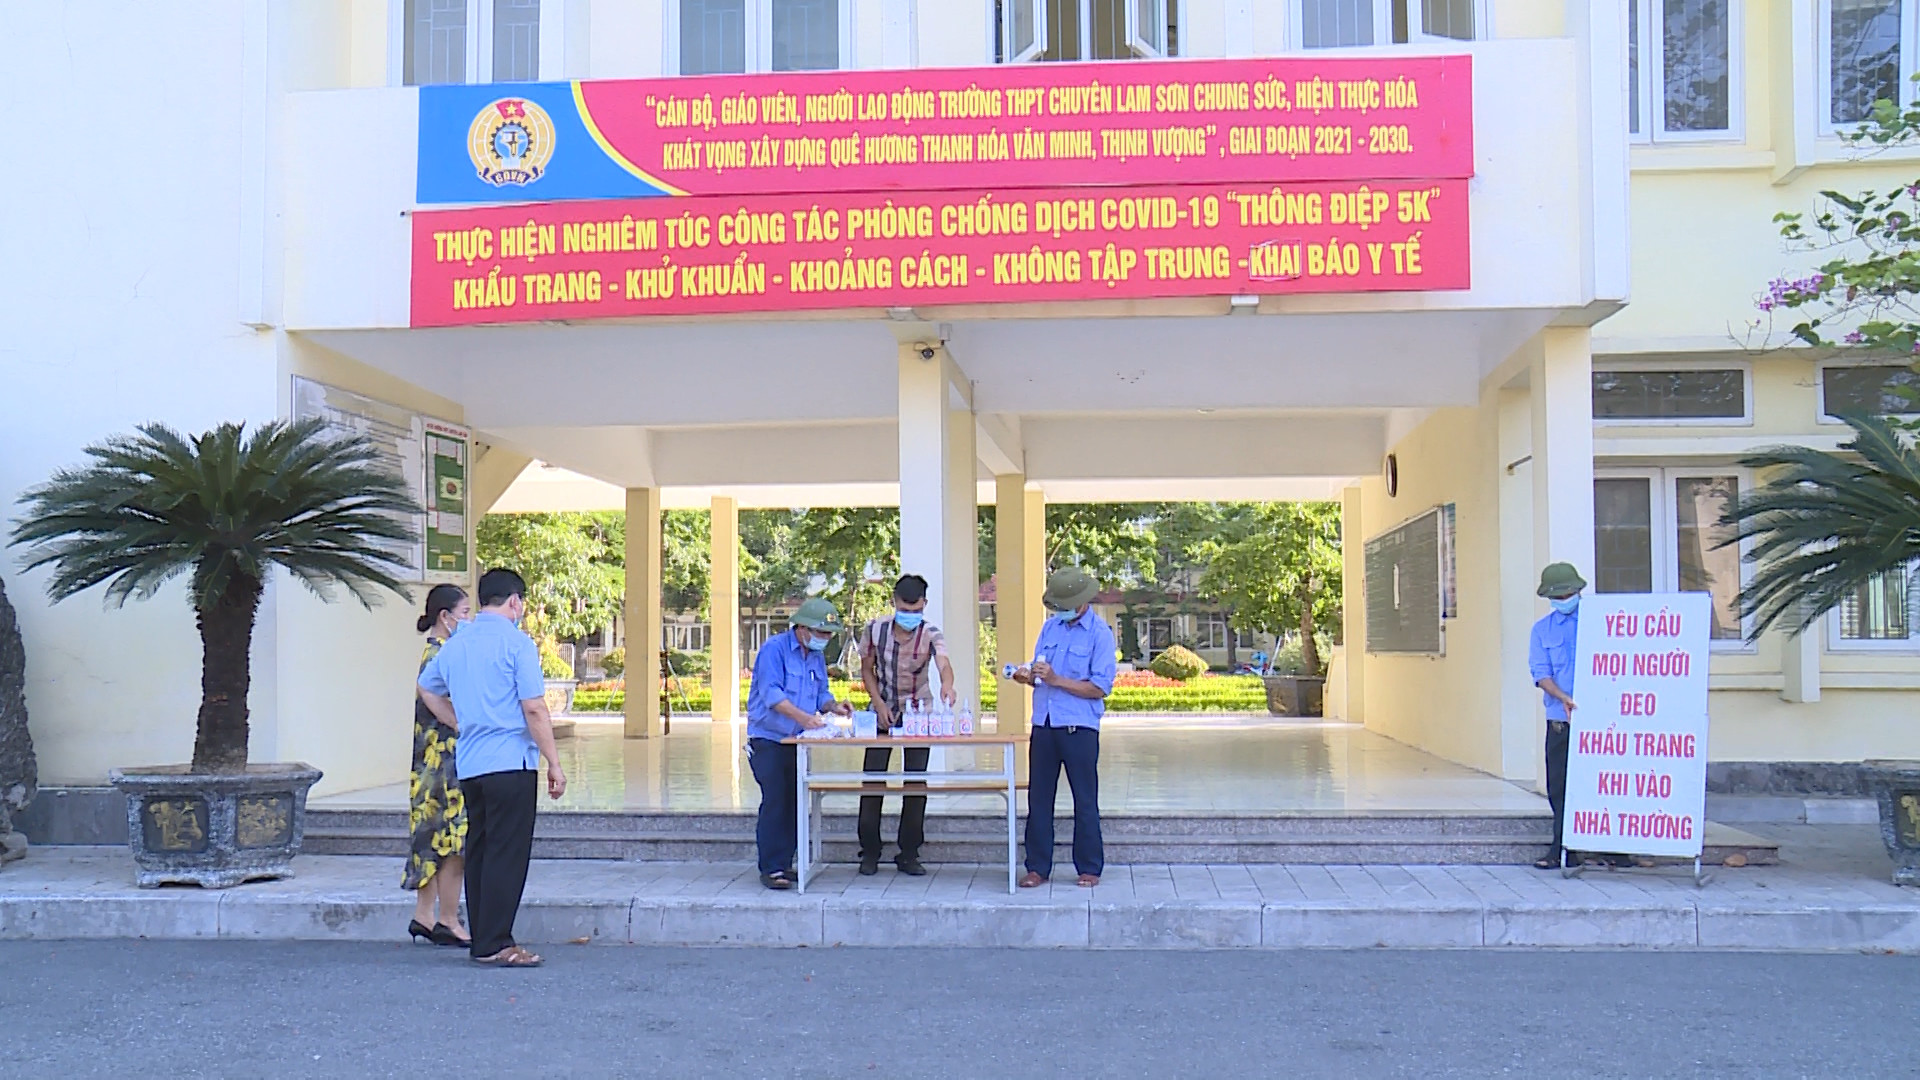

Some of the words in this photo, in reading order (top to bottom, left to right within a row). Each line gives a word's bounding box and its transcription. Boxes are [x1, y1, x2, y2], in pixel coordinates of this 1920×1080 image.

[691, 94, 717, 131] BỘ,
[721, 92, 758, 125] GIÁO
[761, 90, 801, 126] VIÊN,
[805, 87, 854, 123] NGƯỜI
[857, 93, 888, 121] LAO
[890, 86, 935, 125] ĐỘNG
[939, 82, 1002, 119] TRƯỜNG
[1005, 87, 1045, 116] THPT
[1048, 80, 1112, 115] CHUYÊN
[1116, 85, 1151, 113] LAM
[1155, 82, 1190, 113] SƠN
[1193, 82, 1249, 111] CHUNG
[1253, 74, 1291, 112] SỨC,
[1295, 76, 1334, 115] HIỆN
[1338, 78, 1380, 114] THỰC
[1384, 75, 1418, 109] HÓA
[663, 138, 702, 171] KHÁT
[705, 140, 746, 175] VỌNG
[750, 134, 780, 167] XÂY
[783, 136, 827, 172] DỰNG
[830, 132, 860, 168] QUÊ
[864, 134, 918, 164] HƯƠNG
[921, 134, 973, 162] THANH
[977, 127, 1009, 161] HÓA
[1012, 126, 1045, 160] VĂN
[1049, 130, 1097, 161] MINH,
[1101, 129, 1148, 163] THỊNH
[1229, 126, 1262, 155] GIAI
[1265, 126, 1311, 160] ĐOẠN
[1314, 126, 1352, 154] 2021
[1369, 125, 1413, 154] 2030.
[433, 226, 493, 266] THỰC
[500, 219, 556, 263] HIỆN
[562, 214, 658, 254] NGHIÊM
[663, 211, 711, 248] TÚC
[718, 207, 786, 246] CÔNG
[792, 205, 840, 243] TÁC
[845, 199, 933, 240] PHÒNG
[940, 192, 1028, 236] CHỐNG
[1035, 199, 1096, 239] DỊCH
[1101, 195, 1219, 230] COVID-19
[1226, 187, 1323, 226] “THÔNG
[1329, 185, 1390, 231] ĐIỆP
[1397, 187, 1441, 223] 5K”
[453, 265, 516, 310] KHẨU
[523, 271, 602, 304] TRANG
[625, 255, 678, 300] KHỬ
[681, 251, 766, 298] KHUẨN
[790, 246, 892, 292] KHOẢNG
[900, 249, 968, 288] CÁCH
[993, 245, 1081, 285] KHÔNG
[1087, 242, 1137, 288] TẬP
[1143, 246, 1231, 282] TRUNG
[1307, 237, 1360, 276] BÁO
[1367, 242, 1383, 275] Y
[1390, 230, 1422, 274] TẾ
[1605, 609, 1638, 637] YÊU
[1644, 605, 1681, 637] CẦU
[1592, 653, 1627, 682] MỌI
[1632, 647, 1690, 677] NGƯỜI
[1620, 692, 1656, 716] ĐEO
[1578, 721, 1628, 756] KHẨU
[1633, 732, 1695, 758] TRANG
[1598, 771, 1629, 796] KHI
[1635, 769, 1672, 798] VÀO
[1573, 807, 1611, 836] NHÀ
[1618, 809, 1692, 840] TRƯỜNG
